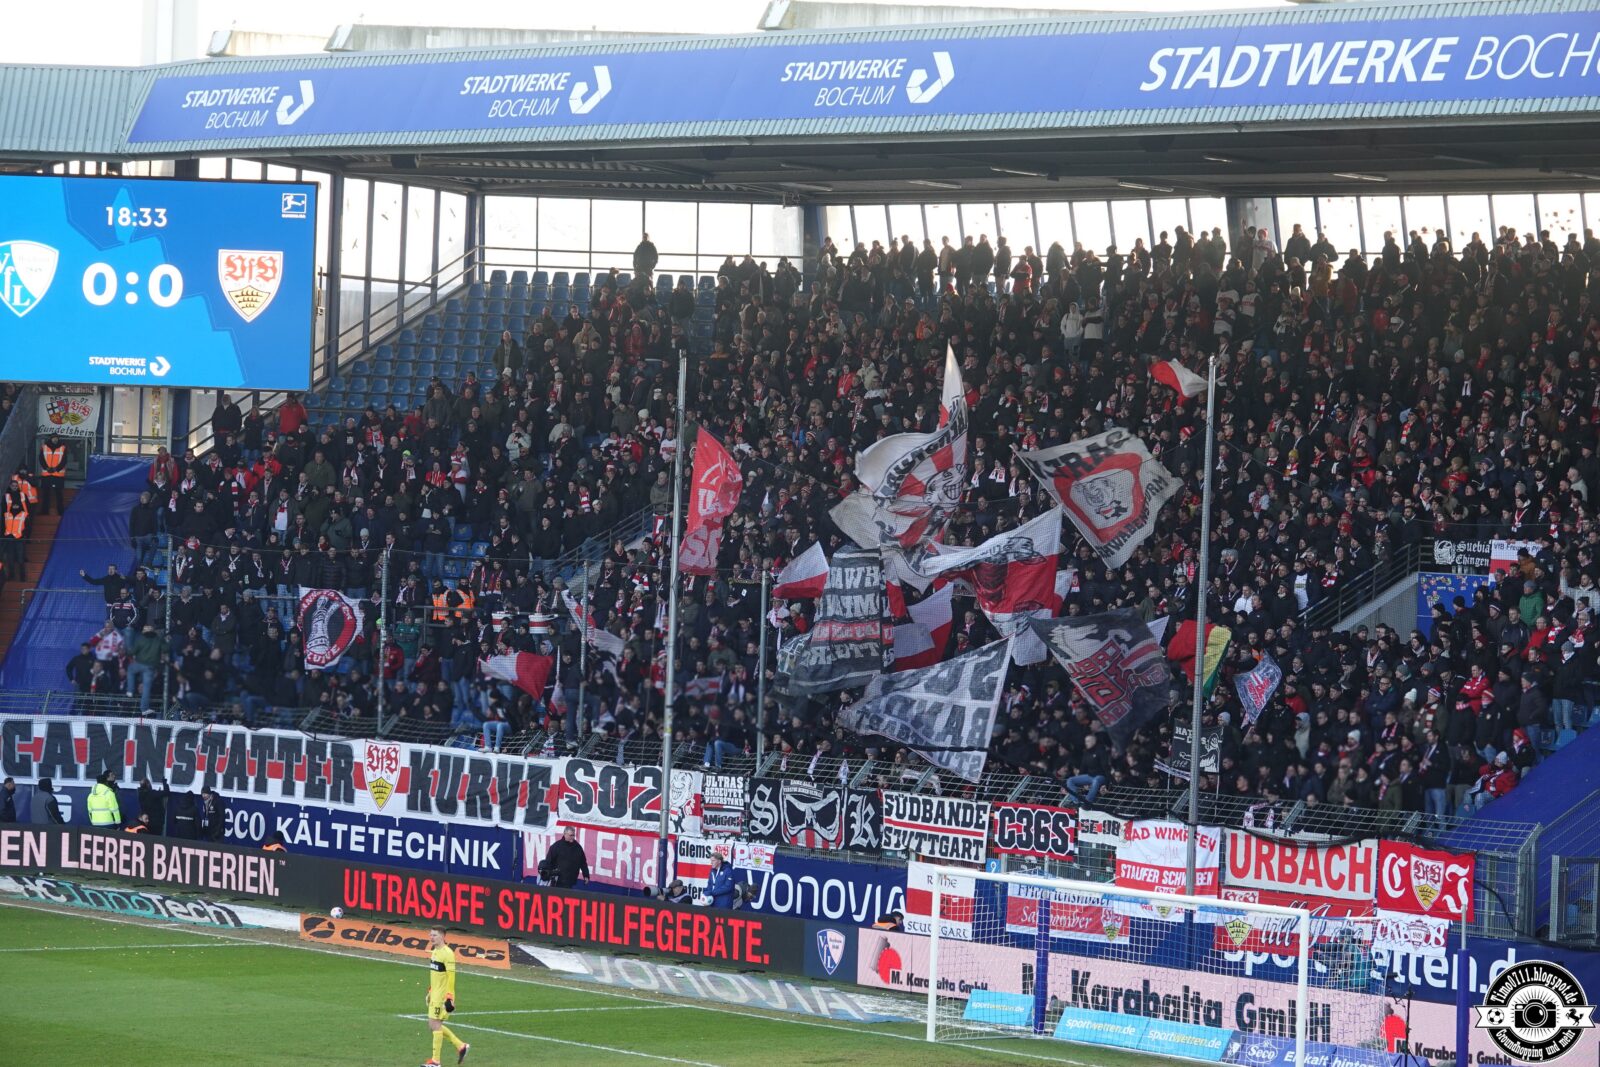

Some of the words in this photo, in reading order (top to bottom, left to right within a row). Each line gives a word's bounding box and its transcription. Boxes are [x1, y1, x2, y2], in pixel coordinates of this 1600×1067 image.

[781, 58, 907, 82] STADTWERKE
[1140, 36, 1459, 91] STADTWERKE
[460, 71, 571, 95] STADTWERKE
[182, 85, 280, 108] STADTWERKE
[488, 97, 560, 118] BOCHUM
[814, 85, 895, 107] BOCHUM
[205, 109, 269, 130] BOCHUM
[105, 206, 168, 228] 18:33
[82, 263, 184, 308] 0:0
[88, 356, 147, 367] STADTWERKE
[109, 367, 147, 377] BOCHUM
[38, 424, 96, 437] Gundelsheim
[1, 719, 355, 805] CANNSTATTER
[406, 748, 553, 828] KURVE
[705, 775, 744, 789] ULTRAS
[705, 787, 744, 799] BEDEUTET
[275, 812, 501, 870] KÄLTETECHNIK
[678, 840, 712, 859] Glems
[881, 829, 985, 861] STUTTGART
[61, 831, 146, 879] LEERER
[1229, 832, 1374, 895] URBACH
[1120, 863, 1160, 884] STAUFER
[1161, 870, 1214, 886] SCHBEN
[497, 888, 770, 965] STARTHILFEGERÄTE.
[340, 925, 507, 962] albaros
[1065, 1016, 1136, 1037] sportwetten.de
[1148, 1028, 1223, 1050] sportwetten.de
